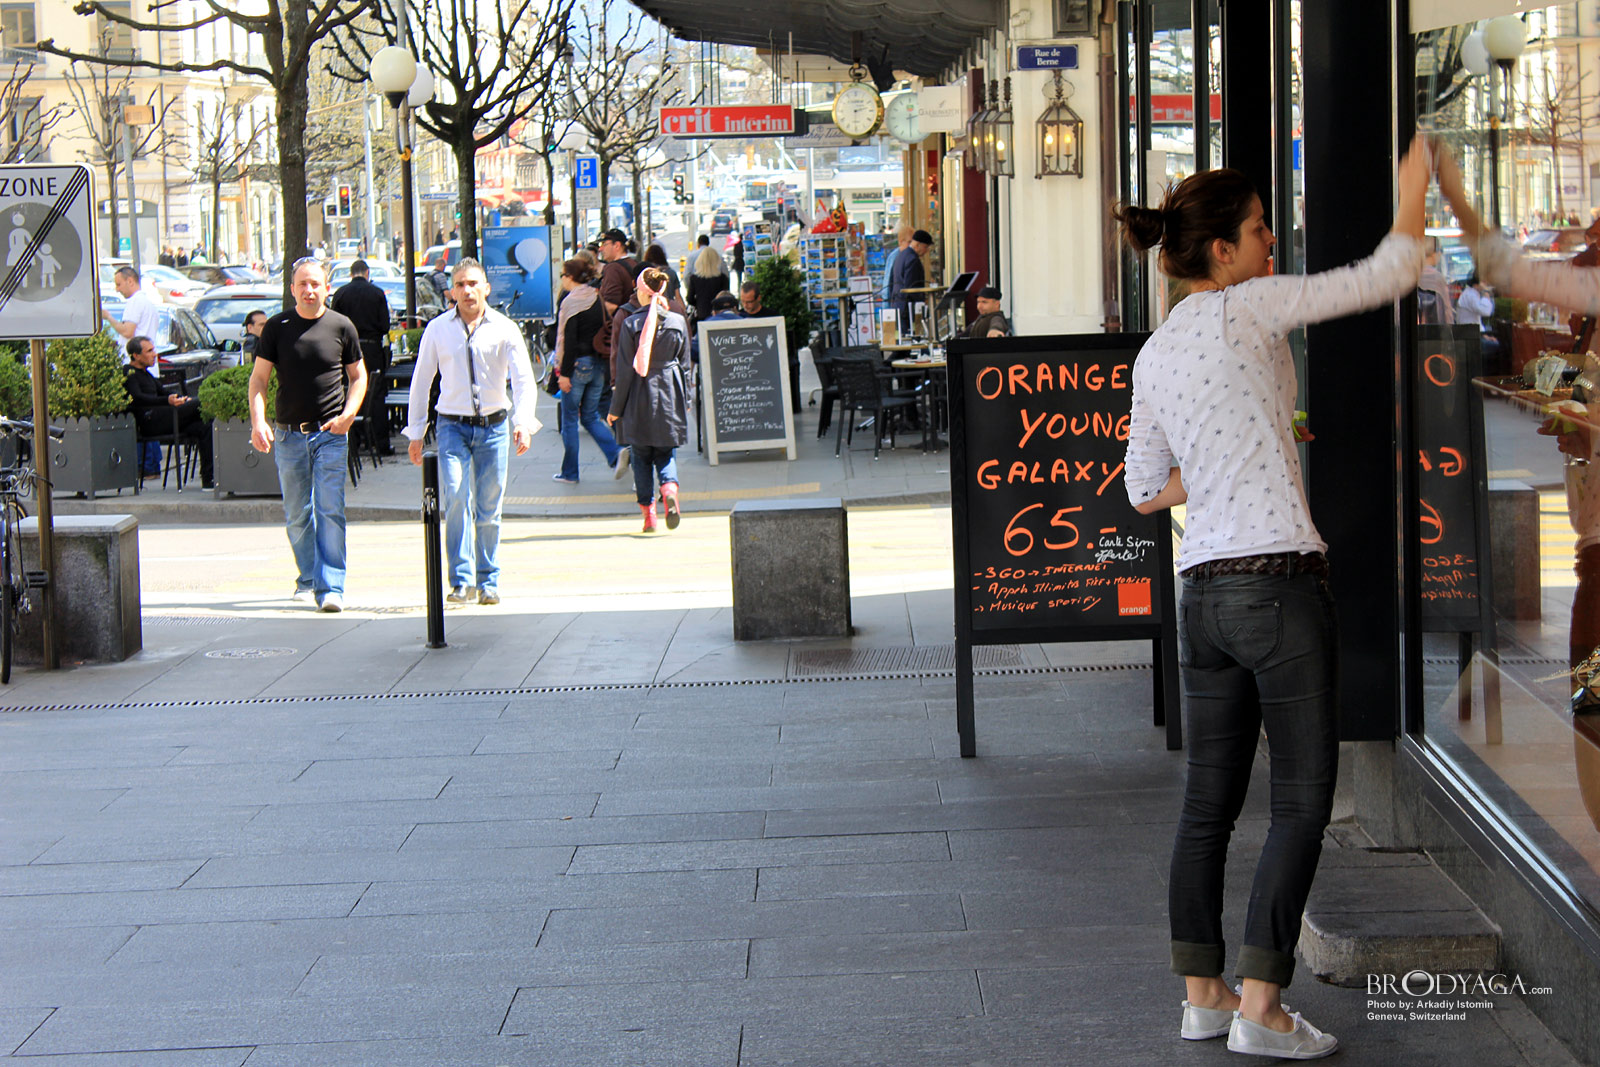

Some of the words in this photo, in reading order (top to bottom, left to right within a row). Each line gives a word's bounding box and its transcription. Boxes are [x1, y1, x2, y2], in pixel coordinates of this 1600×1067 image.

[1035, 48, 1050, 57] Rue
[1050, 48, 1061, 57] de
[1036, 57, 1059, 66] Berne
[663, 108, 715, 133] crit
[580, 160, 590, 175] P
[0, 177, 58, 197] ZONE
[739, 334, 763, 347] BAR
[728, 369, 758, 380] STOP
[976, 362, 1129, 400] ORANGE
[1018, 409, 1130, 449] YOUNG
[976, 458, 1125, 497] GALAXY
[1042, 561, 1114, 577] INTERNET
[1120, 606, 1149, 615] orange
